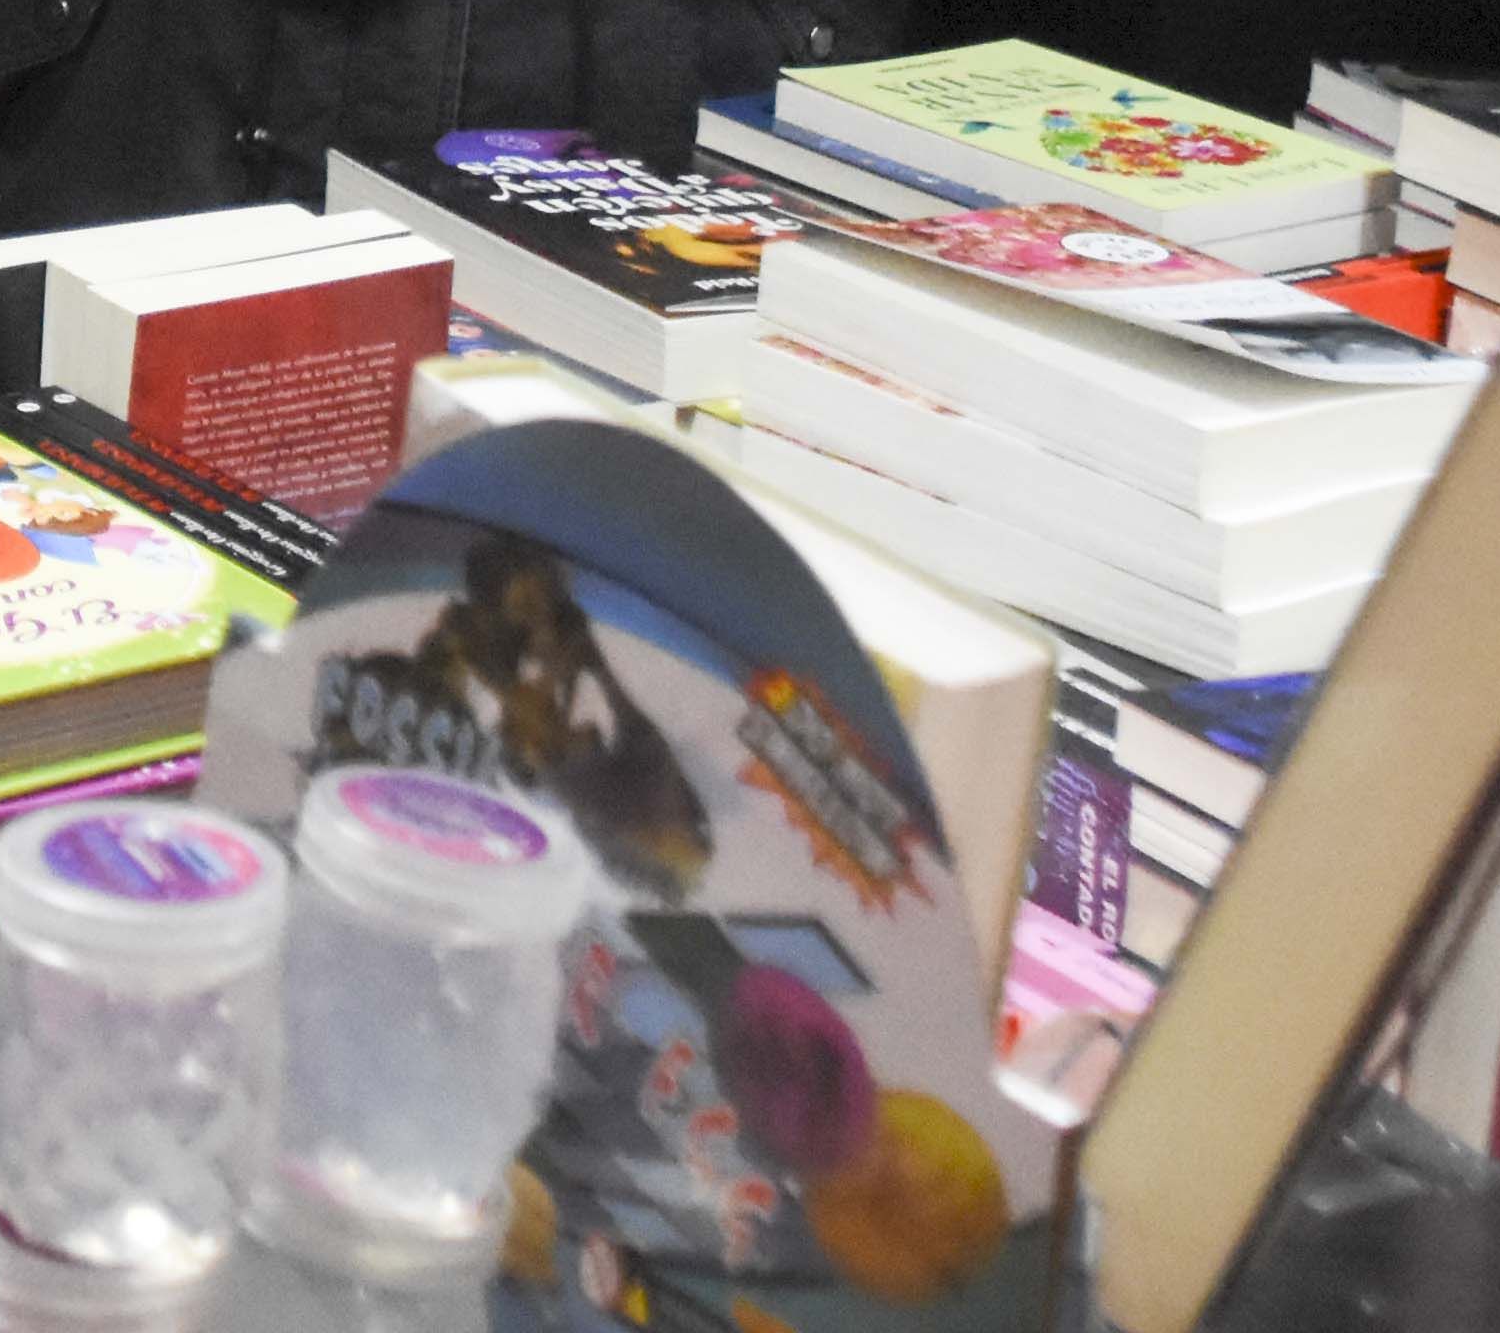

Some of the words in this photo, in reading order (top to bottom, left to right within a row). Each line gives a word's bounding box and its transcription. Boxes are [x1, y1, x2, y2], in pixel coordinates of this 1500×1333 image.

[456, 154, 644, 178] Jones
[489, 174, 685, 201] Daisy
[523, 186, 776, 217] quieren
[589, 210, 803, 237] Todos
